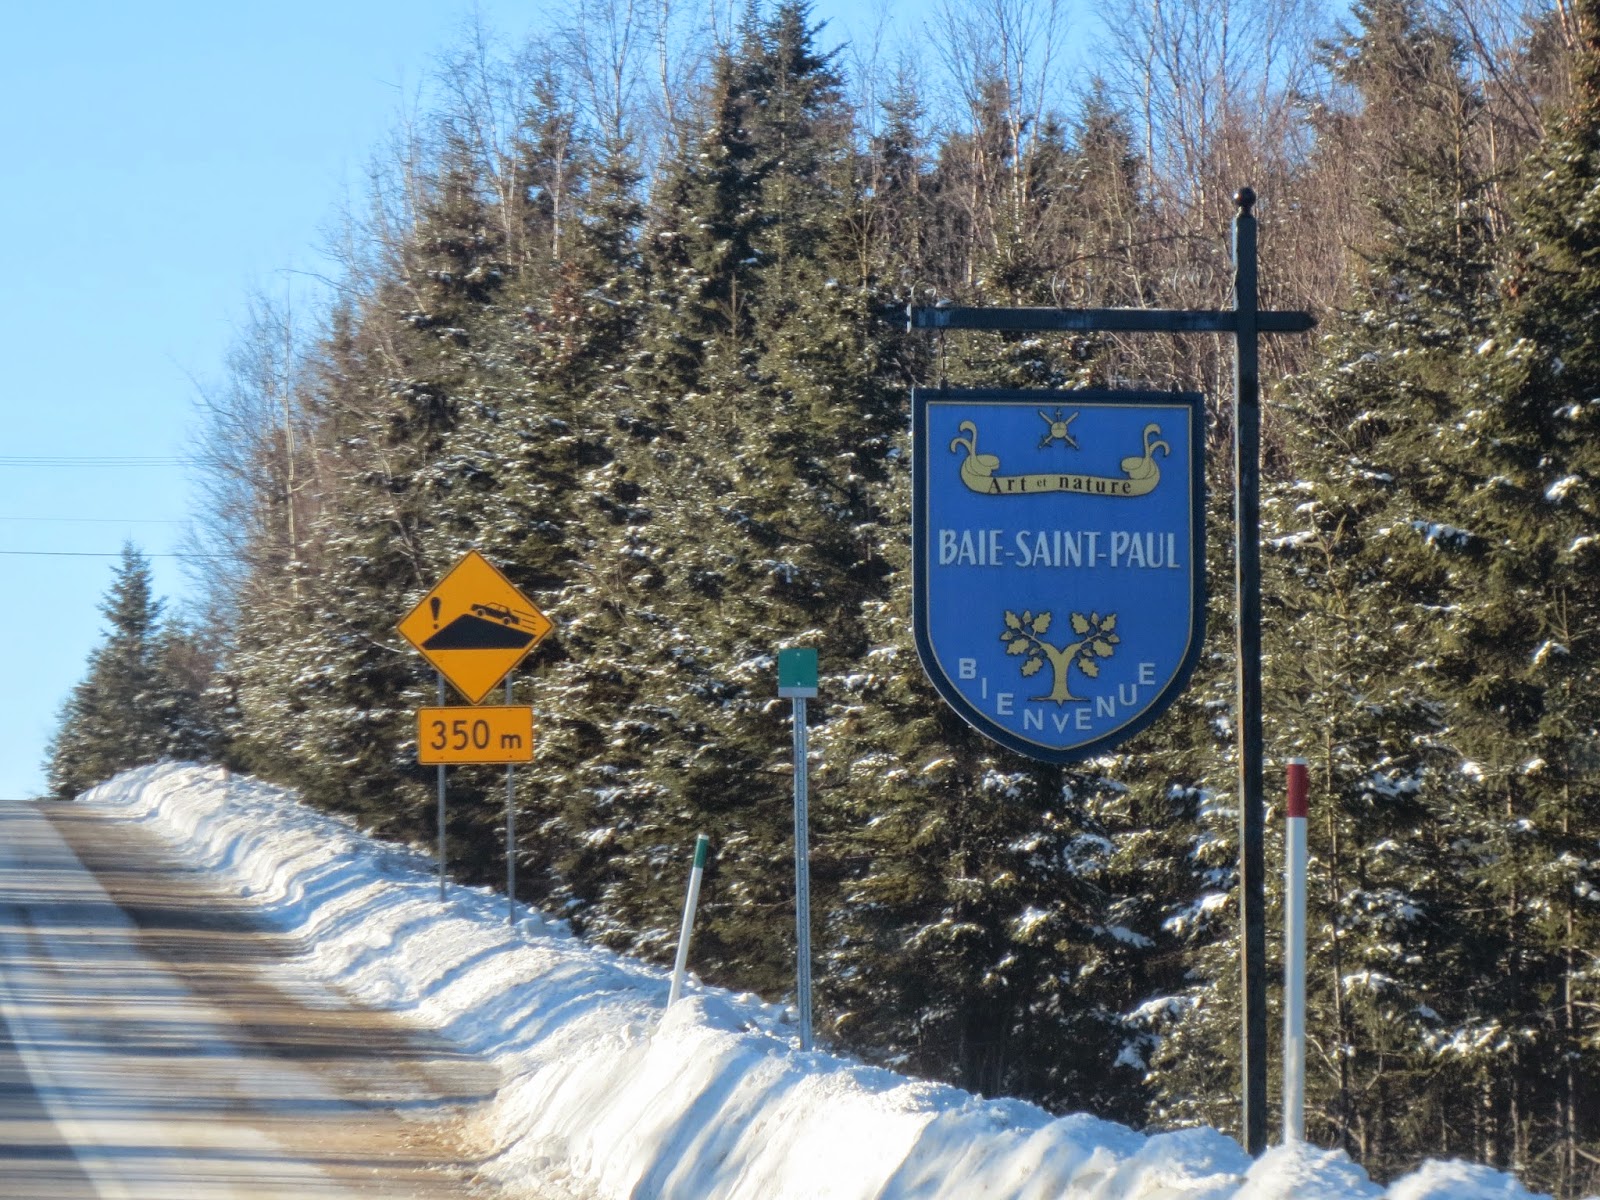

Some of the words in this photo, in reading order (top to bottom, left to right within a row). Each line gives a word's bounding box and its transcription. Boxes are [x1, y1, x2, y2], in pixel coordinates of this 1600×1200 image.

[988, 476, 1027, 494] Art
[1036, 477, 1047, 488] et
[1059, 475, 1132, 495] nature
[939, 529, 1181, 568] BAIE-SAINT-PAUL
[959, 658, 1156, 734] BIENVENUE
[431, 719, 490, 750] 350
[501, 734, 522, 749] m
